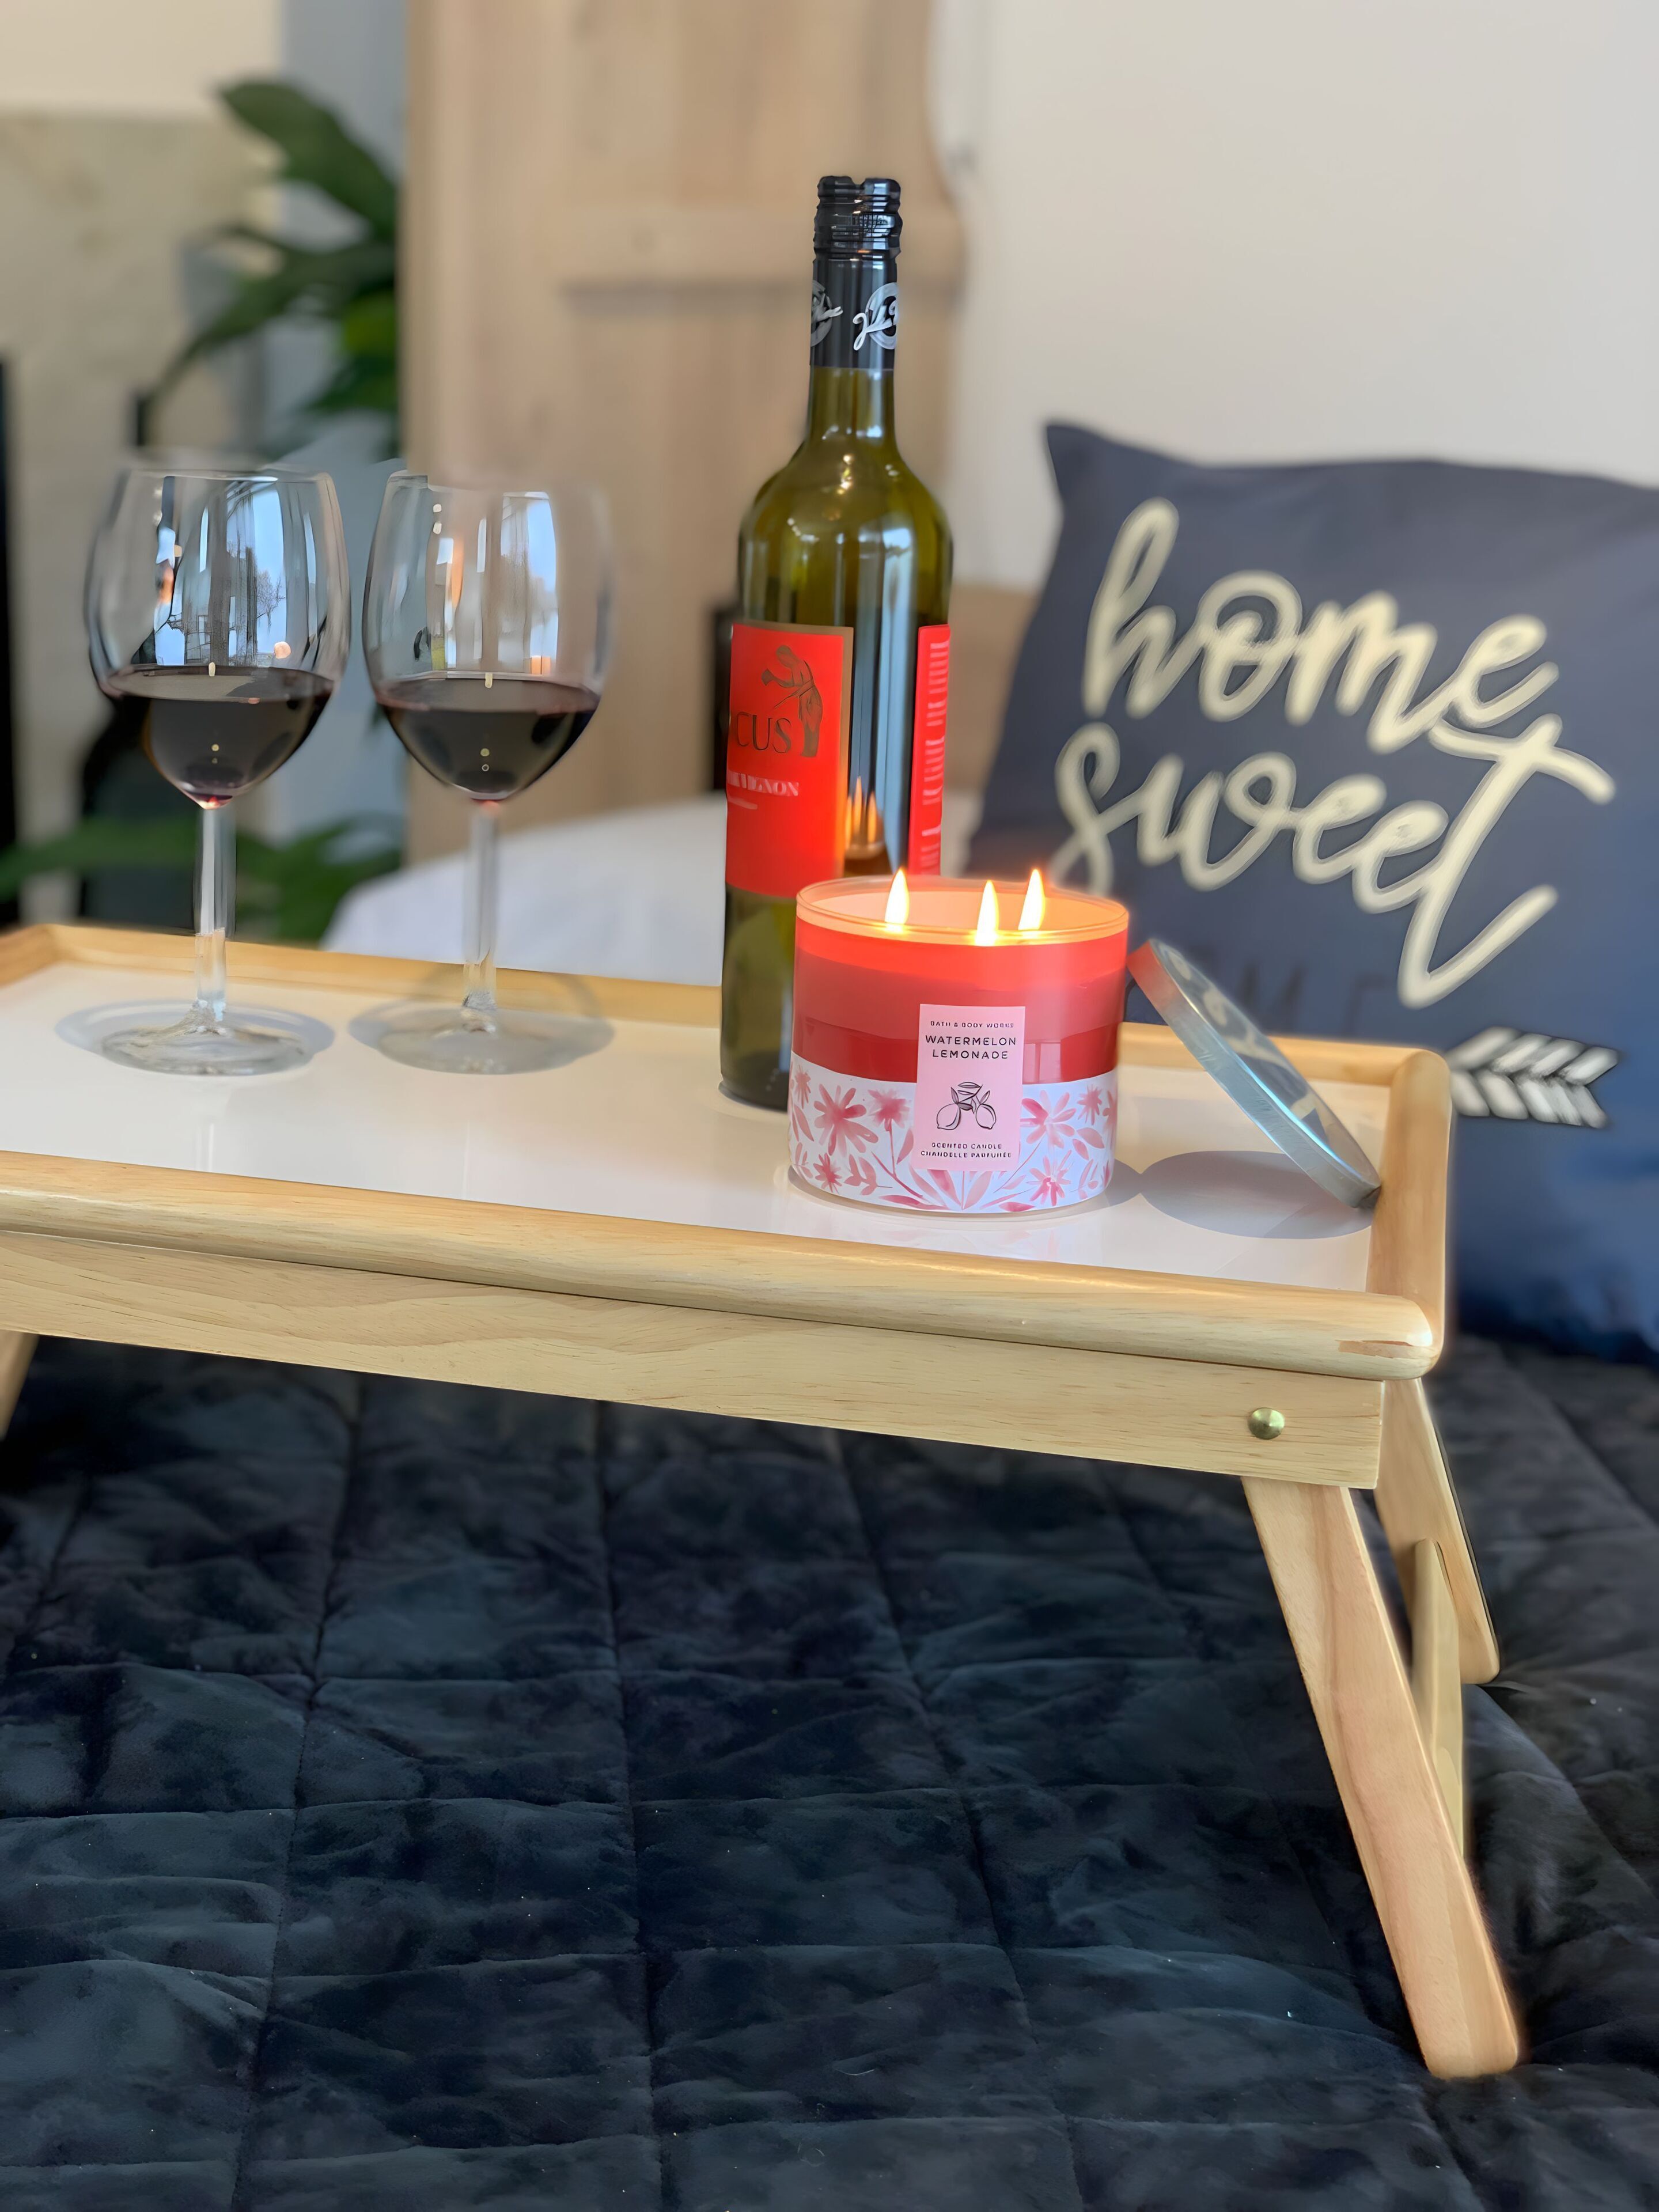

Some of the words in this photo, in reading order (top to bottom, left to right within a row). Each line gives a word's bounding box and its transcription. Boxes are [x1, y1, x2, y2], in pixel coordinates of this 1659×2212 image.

[1083, 497, 1559, 753] home
[1050, 714, 1615, 1007] sweet
[925, 1035, 1016, 1046] WATERMELON
[933, 1049, 1008, 1059] LEMONADE
